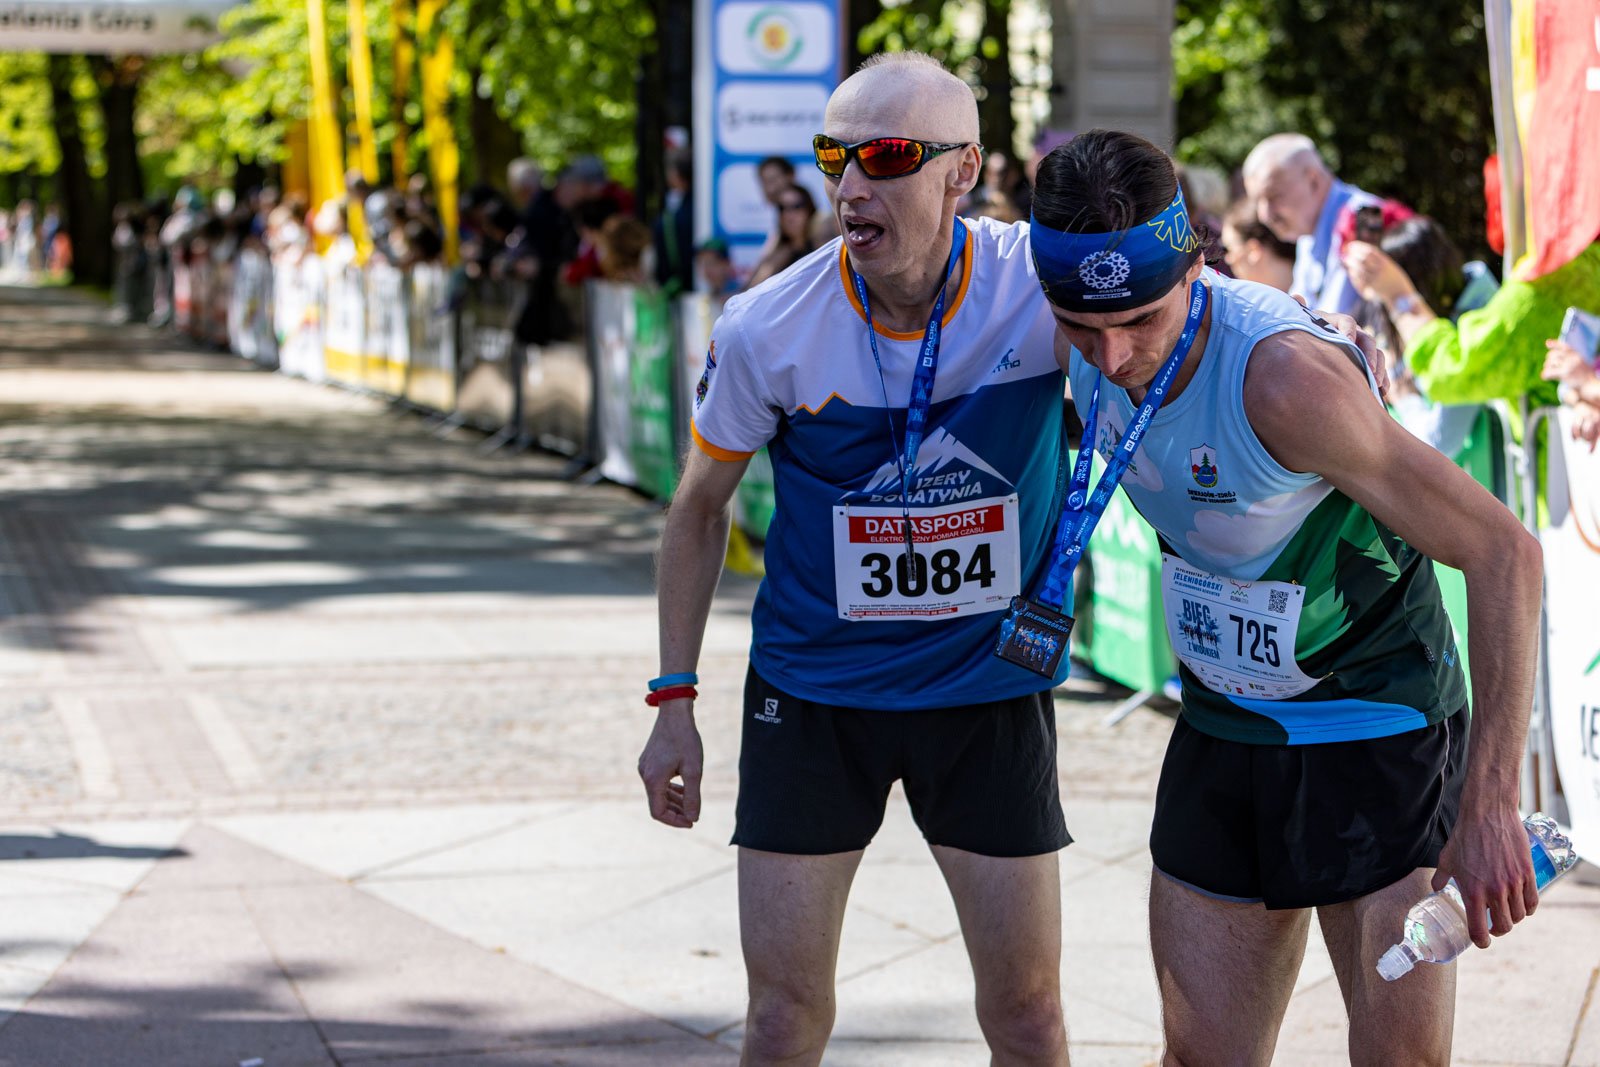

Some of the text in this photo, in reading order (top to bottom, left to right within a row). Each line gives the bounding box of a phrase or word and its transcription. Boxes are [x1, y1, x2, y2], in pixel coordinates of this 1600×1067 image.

[925, 320, 935, 356] RADIO
[1160, 354, 1179, 387] SCOTT
[1130, 404, 1151, 440] RADIO
[915, 469, 971, 490] IZERY
[865, 509, 989, 534] DATASPORT
[870, 526, 984, 543] ELEKTROCZNY POMIAR CZASU
[861, 543, 996, 599] 3084
[1173, 571, 1223, 592] JELENIOGÓRSKI
[1182, 598, 1211, 626] BIEG
[1229, 613, 1280, 668] 725
